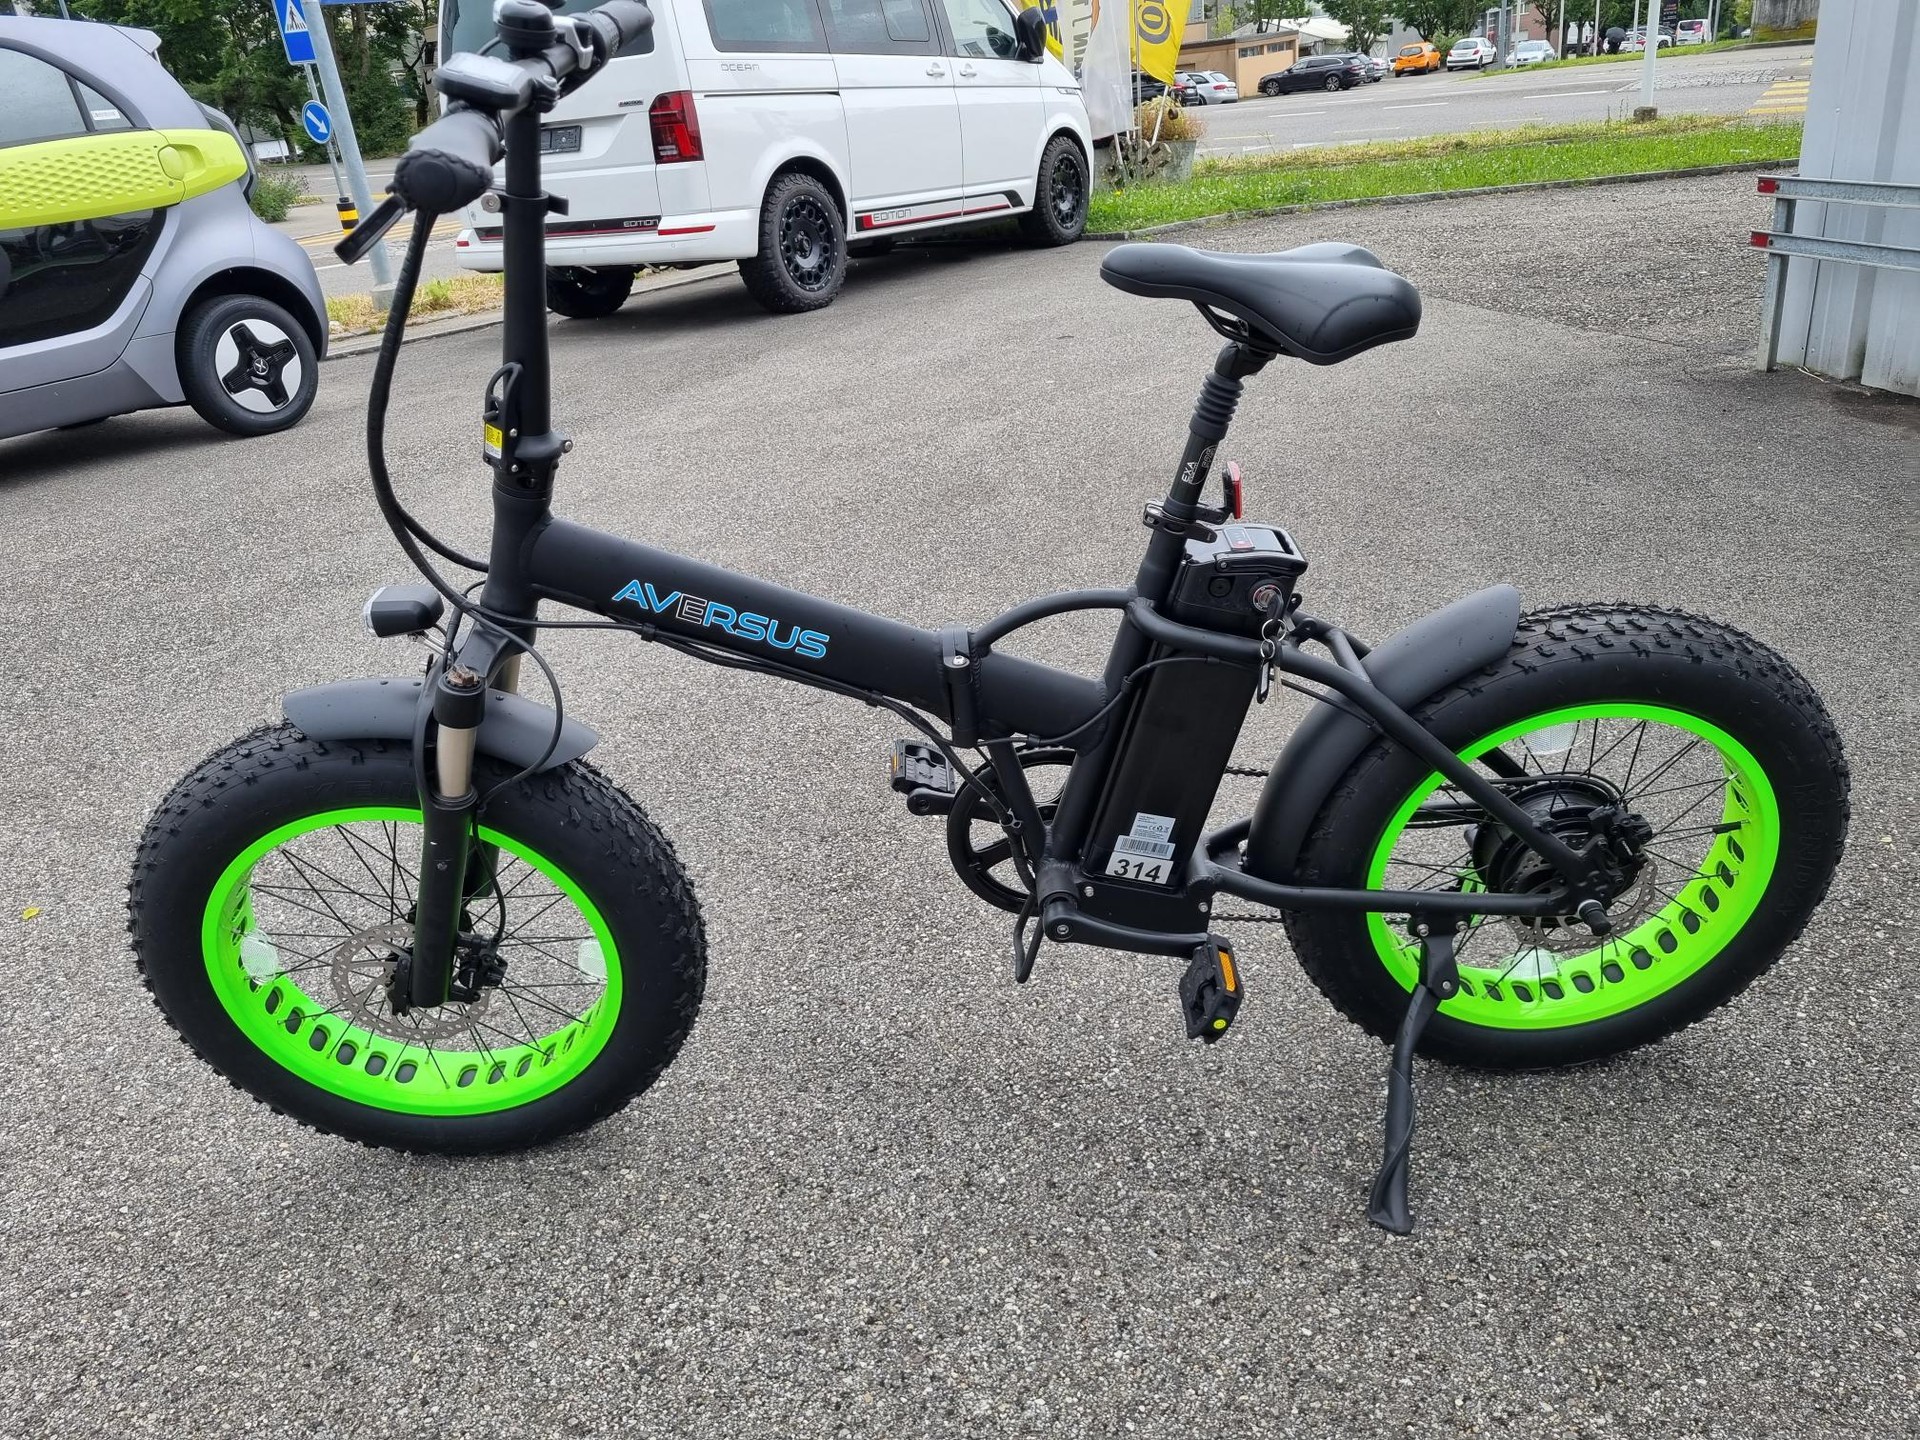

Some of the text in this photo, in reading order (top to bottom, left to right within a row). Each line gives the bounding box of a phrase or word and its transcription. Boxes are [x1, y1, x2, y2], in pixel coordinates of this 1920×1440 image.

[720, 63, 760, 72] OCEAN
[623, 219, 659, 228] EDITION
[873, 208, 912, 222] EDITION
[1181, 461, 1196, 483] EXA
[611, 579, 830, 659] AVERSUS
[1113, 858, 1162, 882] 314
